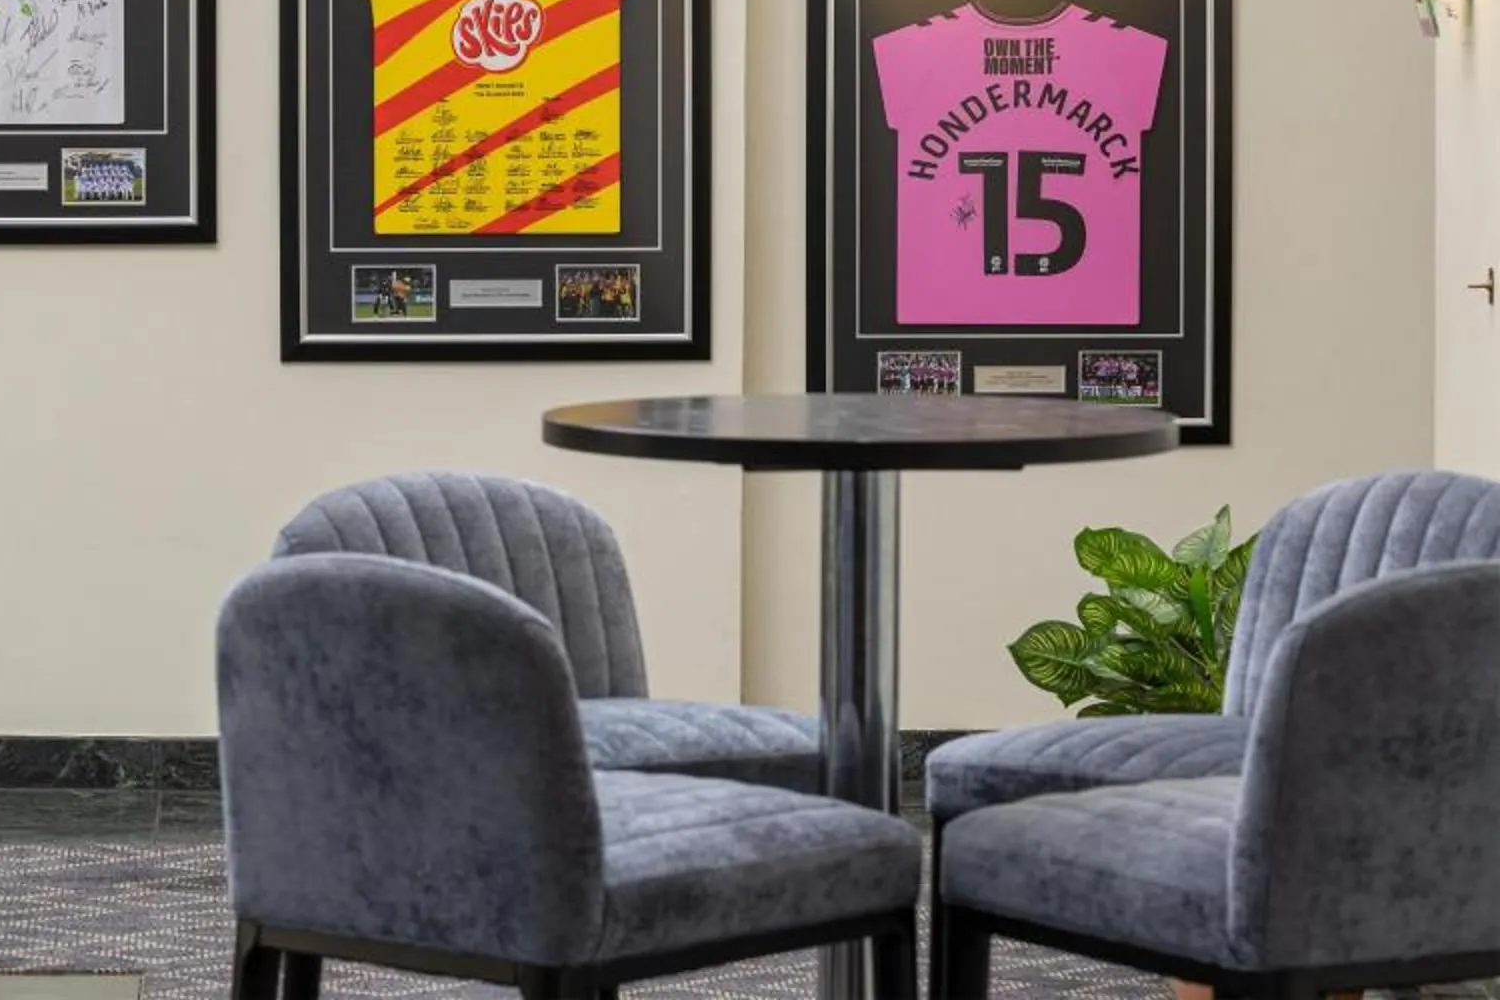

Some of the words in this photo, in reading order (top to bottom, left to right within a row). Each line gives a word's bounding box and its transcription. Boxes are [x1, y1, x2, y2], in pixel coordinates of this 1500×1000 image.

[984, 38, 1021, 56] OWN
[1025, 38, 1055, 56] THE
[984, 56, 1054, 75] MOMENT
[907, 80, 1140, 180] HONDERMARCK
[958, 150, 1087, 276] 15
